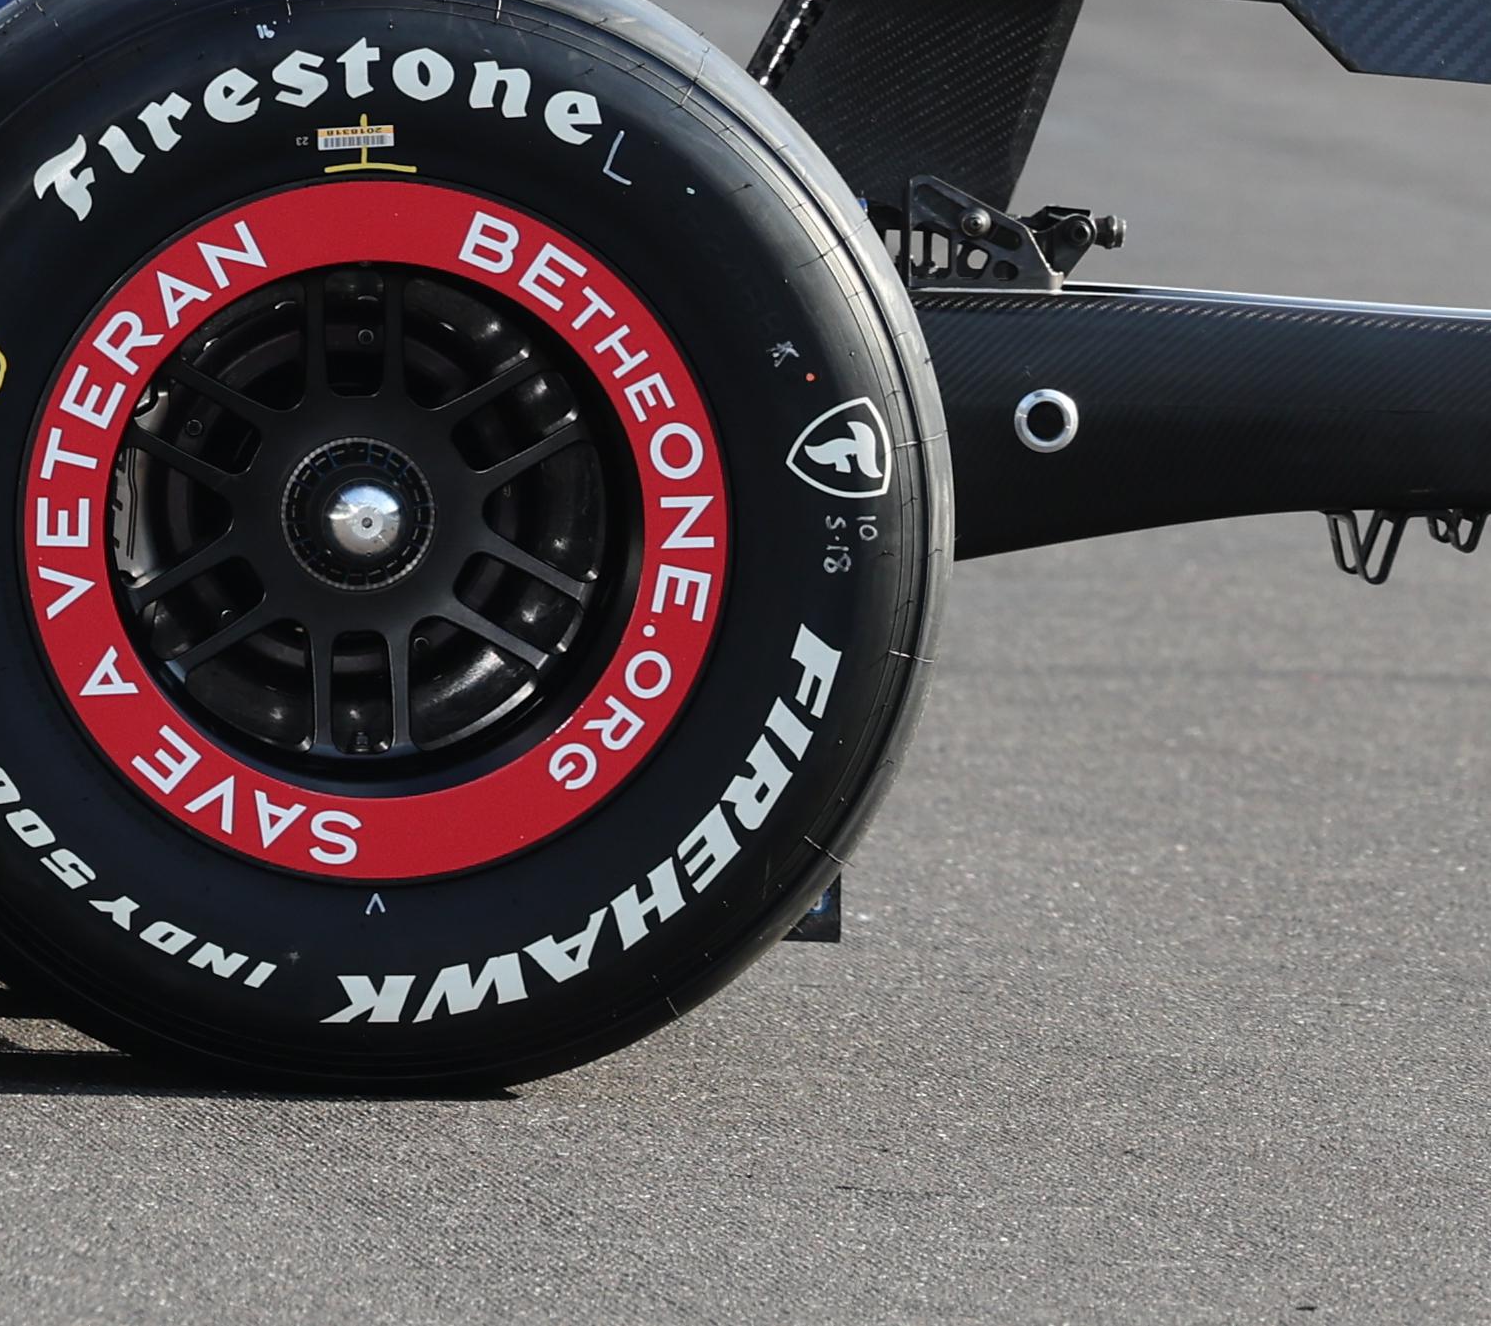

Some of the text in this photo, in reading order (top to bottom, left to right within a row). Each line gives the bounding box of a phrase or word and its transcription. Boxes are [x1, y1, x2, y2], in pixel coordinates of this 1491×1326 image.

[34, 37, 603, 222] Firestone
[36, 220, 363, 865] SAVE A VETERAN
[88, 895, 278, 988] INDY
[319, 622, 843, 1024] FIREHAWK
